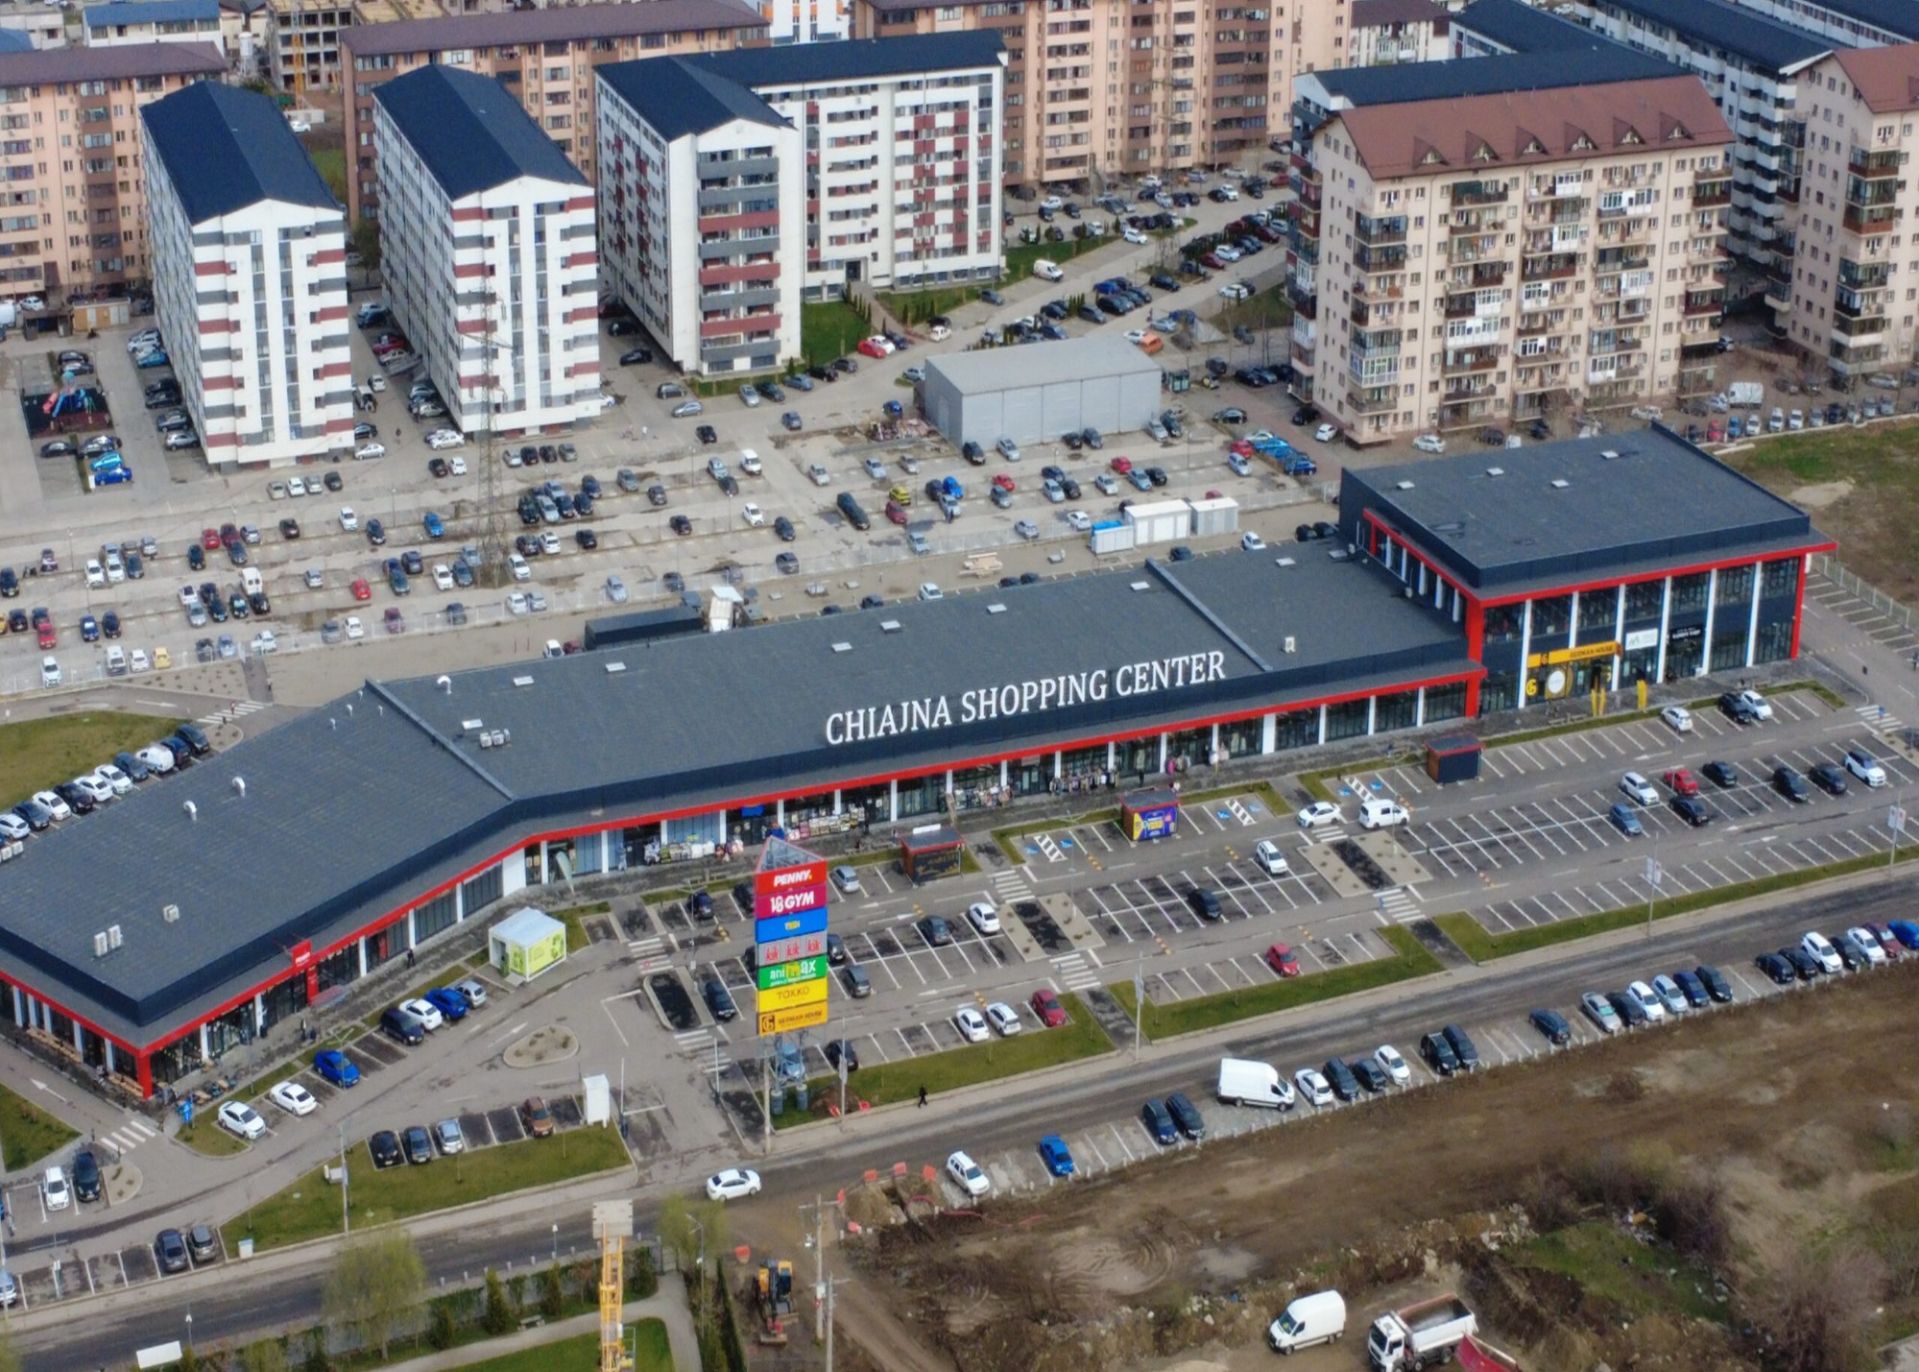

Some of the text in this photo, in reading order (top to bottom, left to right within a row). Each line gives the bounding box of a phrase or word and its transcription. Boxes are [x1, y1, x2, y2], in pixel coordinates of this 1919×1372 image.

[826, 650, 1227, 746] CHIAJNA SHOPPING CENTER
